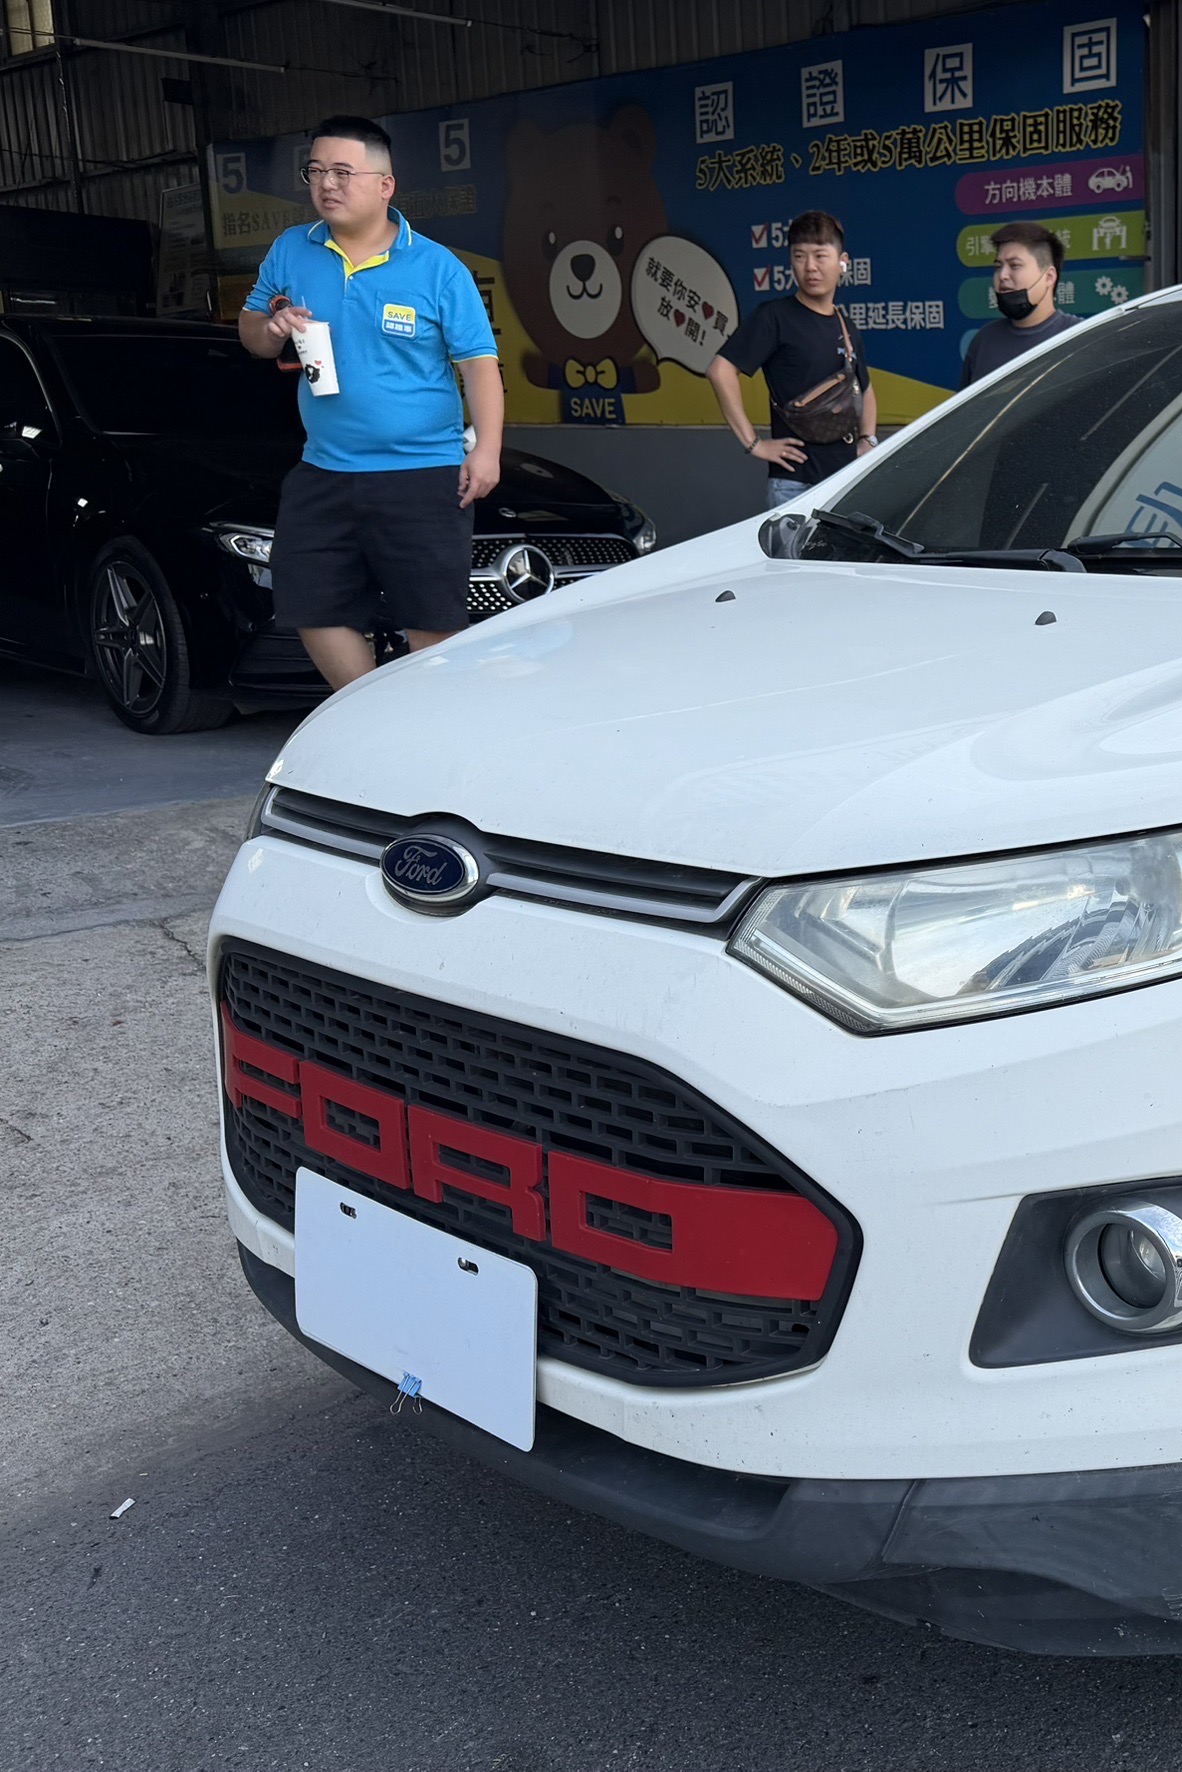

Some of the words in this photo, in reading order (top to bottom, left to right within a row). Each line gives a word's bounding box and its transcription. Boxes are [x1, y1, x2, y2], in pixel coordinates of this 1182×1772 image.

[984, 173, 1073, 204] 方向機本體
[387, 311, 412, 322] SAVE
[570, 397, 617, 419] SAVE
[394, 845, 448, 886] Ford
[220, 1003, 839, 1301] FORD
